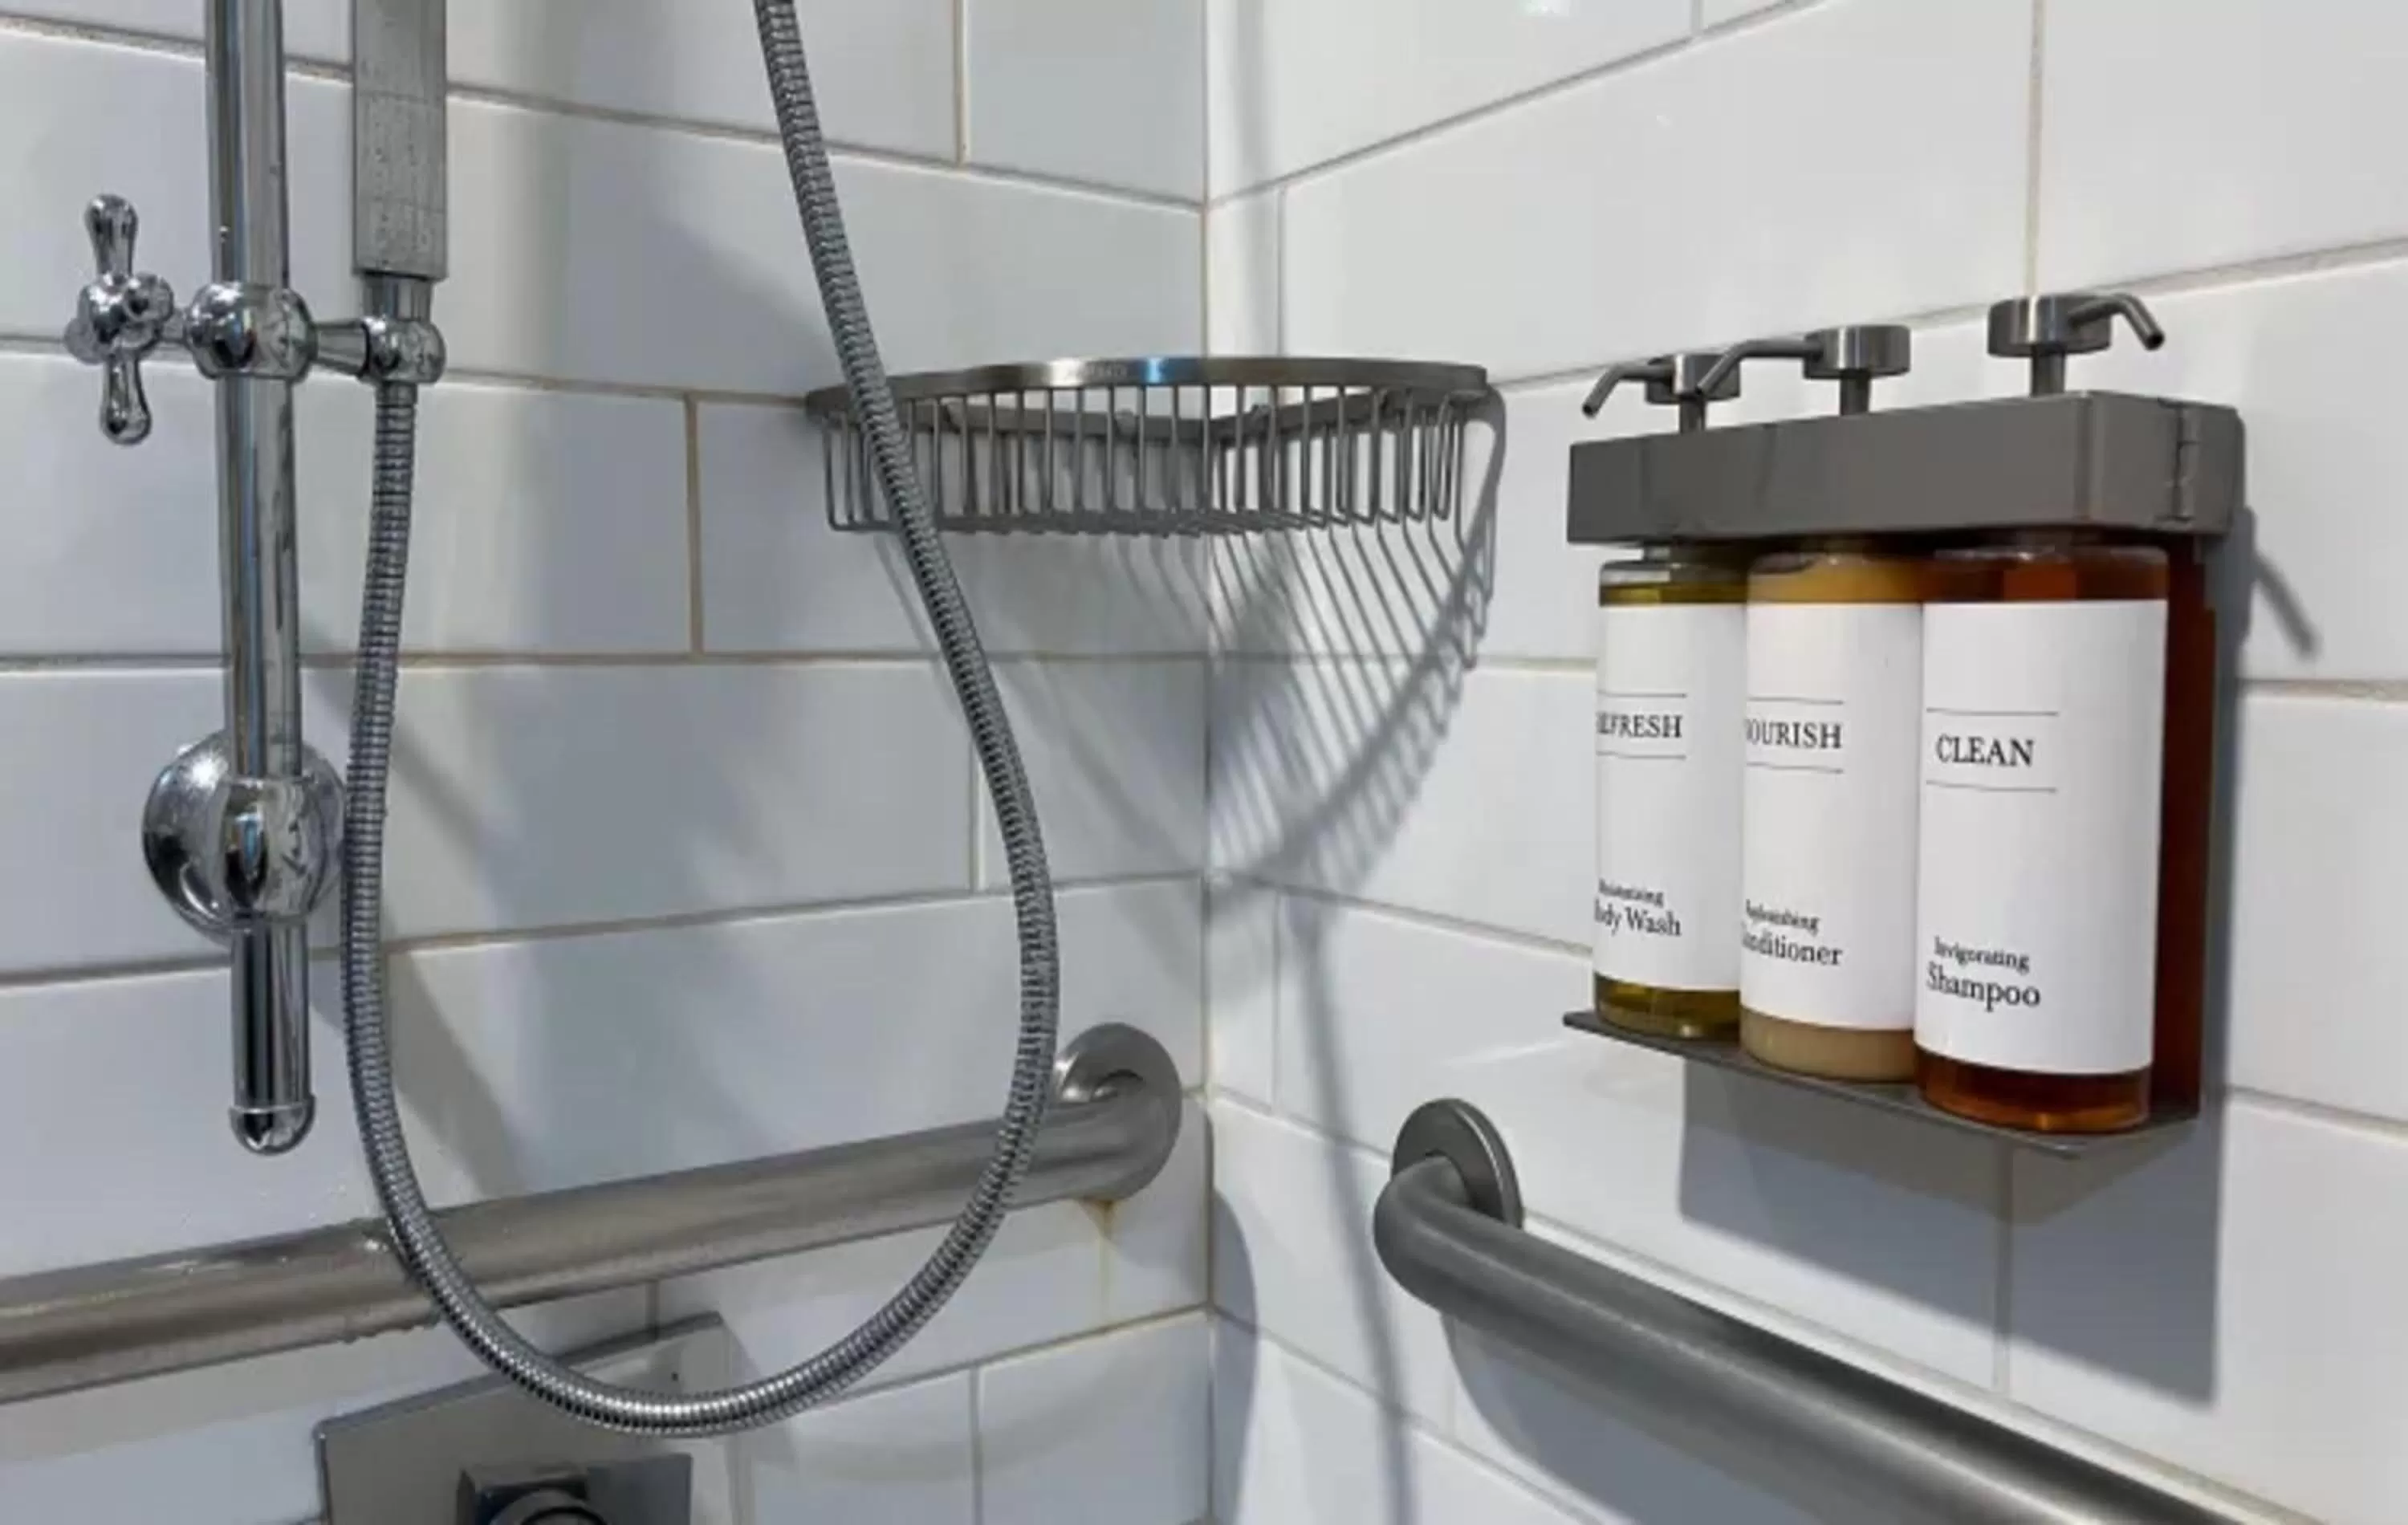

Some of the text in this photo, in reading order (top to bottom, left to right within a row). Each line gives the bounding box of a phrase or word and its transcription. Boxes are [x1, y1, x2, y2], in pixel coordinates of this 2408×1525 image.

[1595, 711, 1682, 738] EFRESH
[1745, 719, 1843, 749] OURISH
[1935, 734, 2035, 767] CLEAN
[1624, 906, 1682, 937] Wash
[1934, 934, 2030, 976] Invigorating
[1926, 961, 2041, 1013] Shampoo
